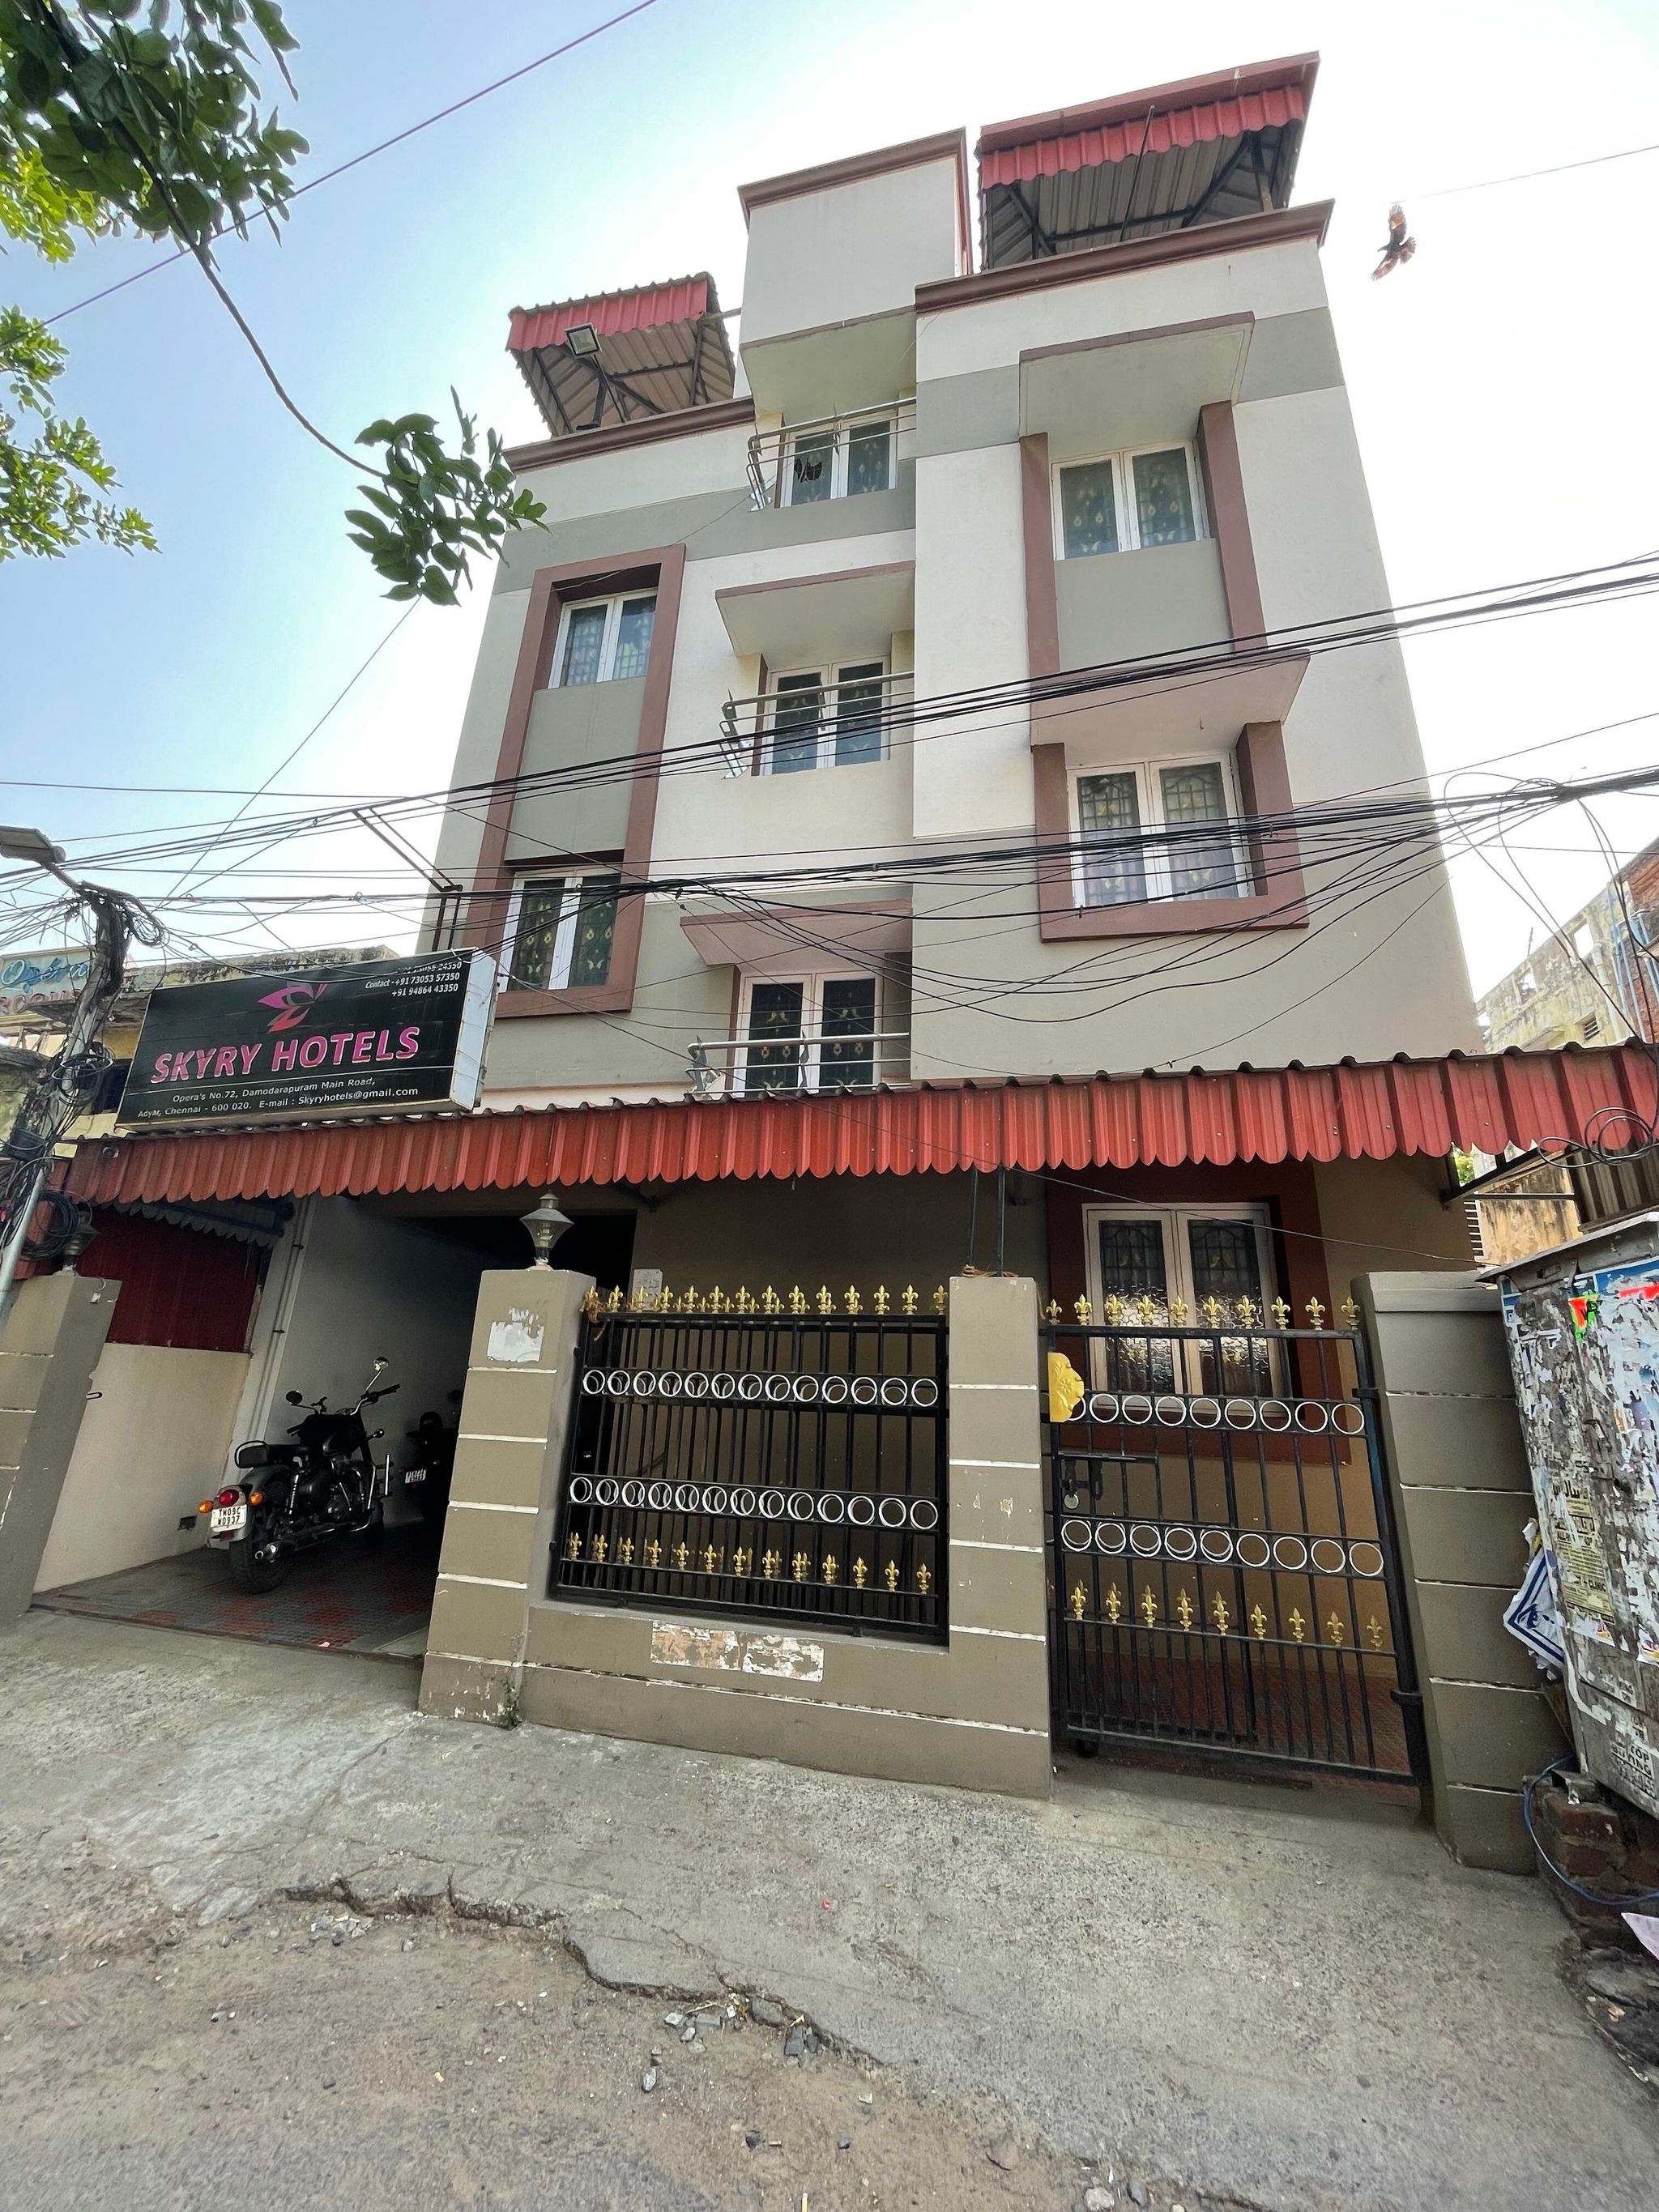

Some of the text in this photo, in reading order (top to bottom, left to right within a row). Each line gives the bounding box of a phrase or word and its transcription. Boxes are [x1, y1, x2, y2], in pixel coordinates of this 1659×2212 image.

[365, 978, 390, 988] Contact
[410, 974, 433, 984] 73053
[435, 972, 460, 982] 57350
[392, 983, 458, 997] +91 94864 43350
[151, 1026, 420, 1083] SKYRY HOTELS
[138, 1109, 161, 1119] Adyar,
[164, 1105, 201, 1115] Chennai
[211, 1103, 229, 1112] 600
[258, 1097, 288, 1109] E-mail
[298, 1087, 418, 1106] Skyryhotels@gmail.com
[173, 1076, 376, 1103] Opera's No.72, Damodarapuram Main Road,
